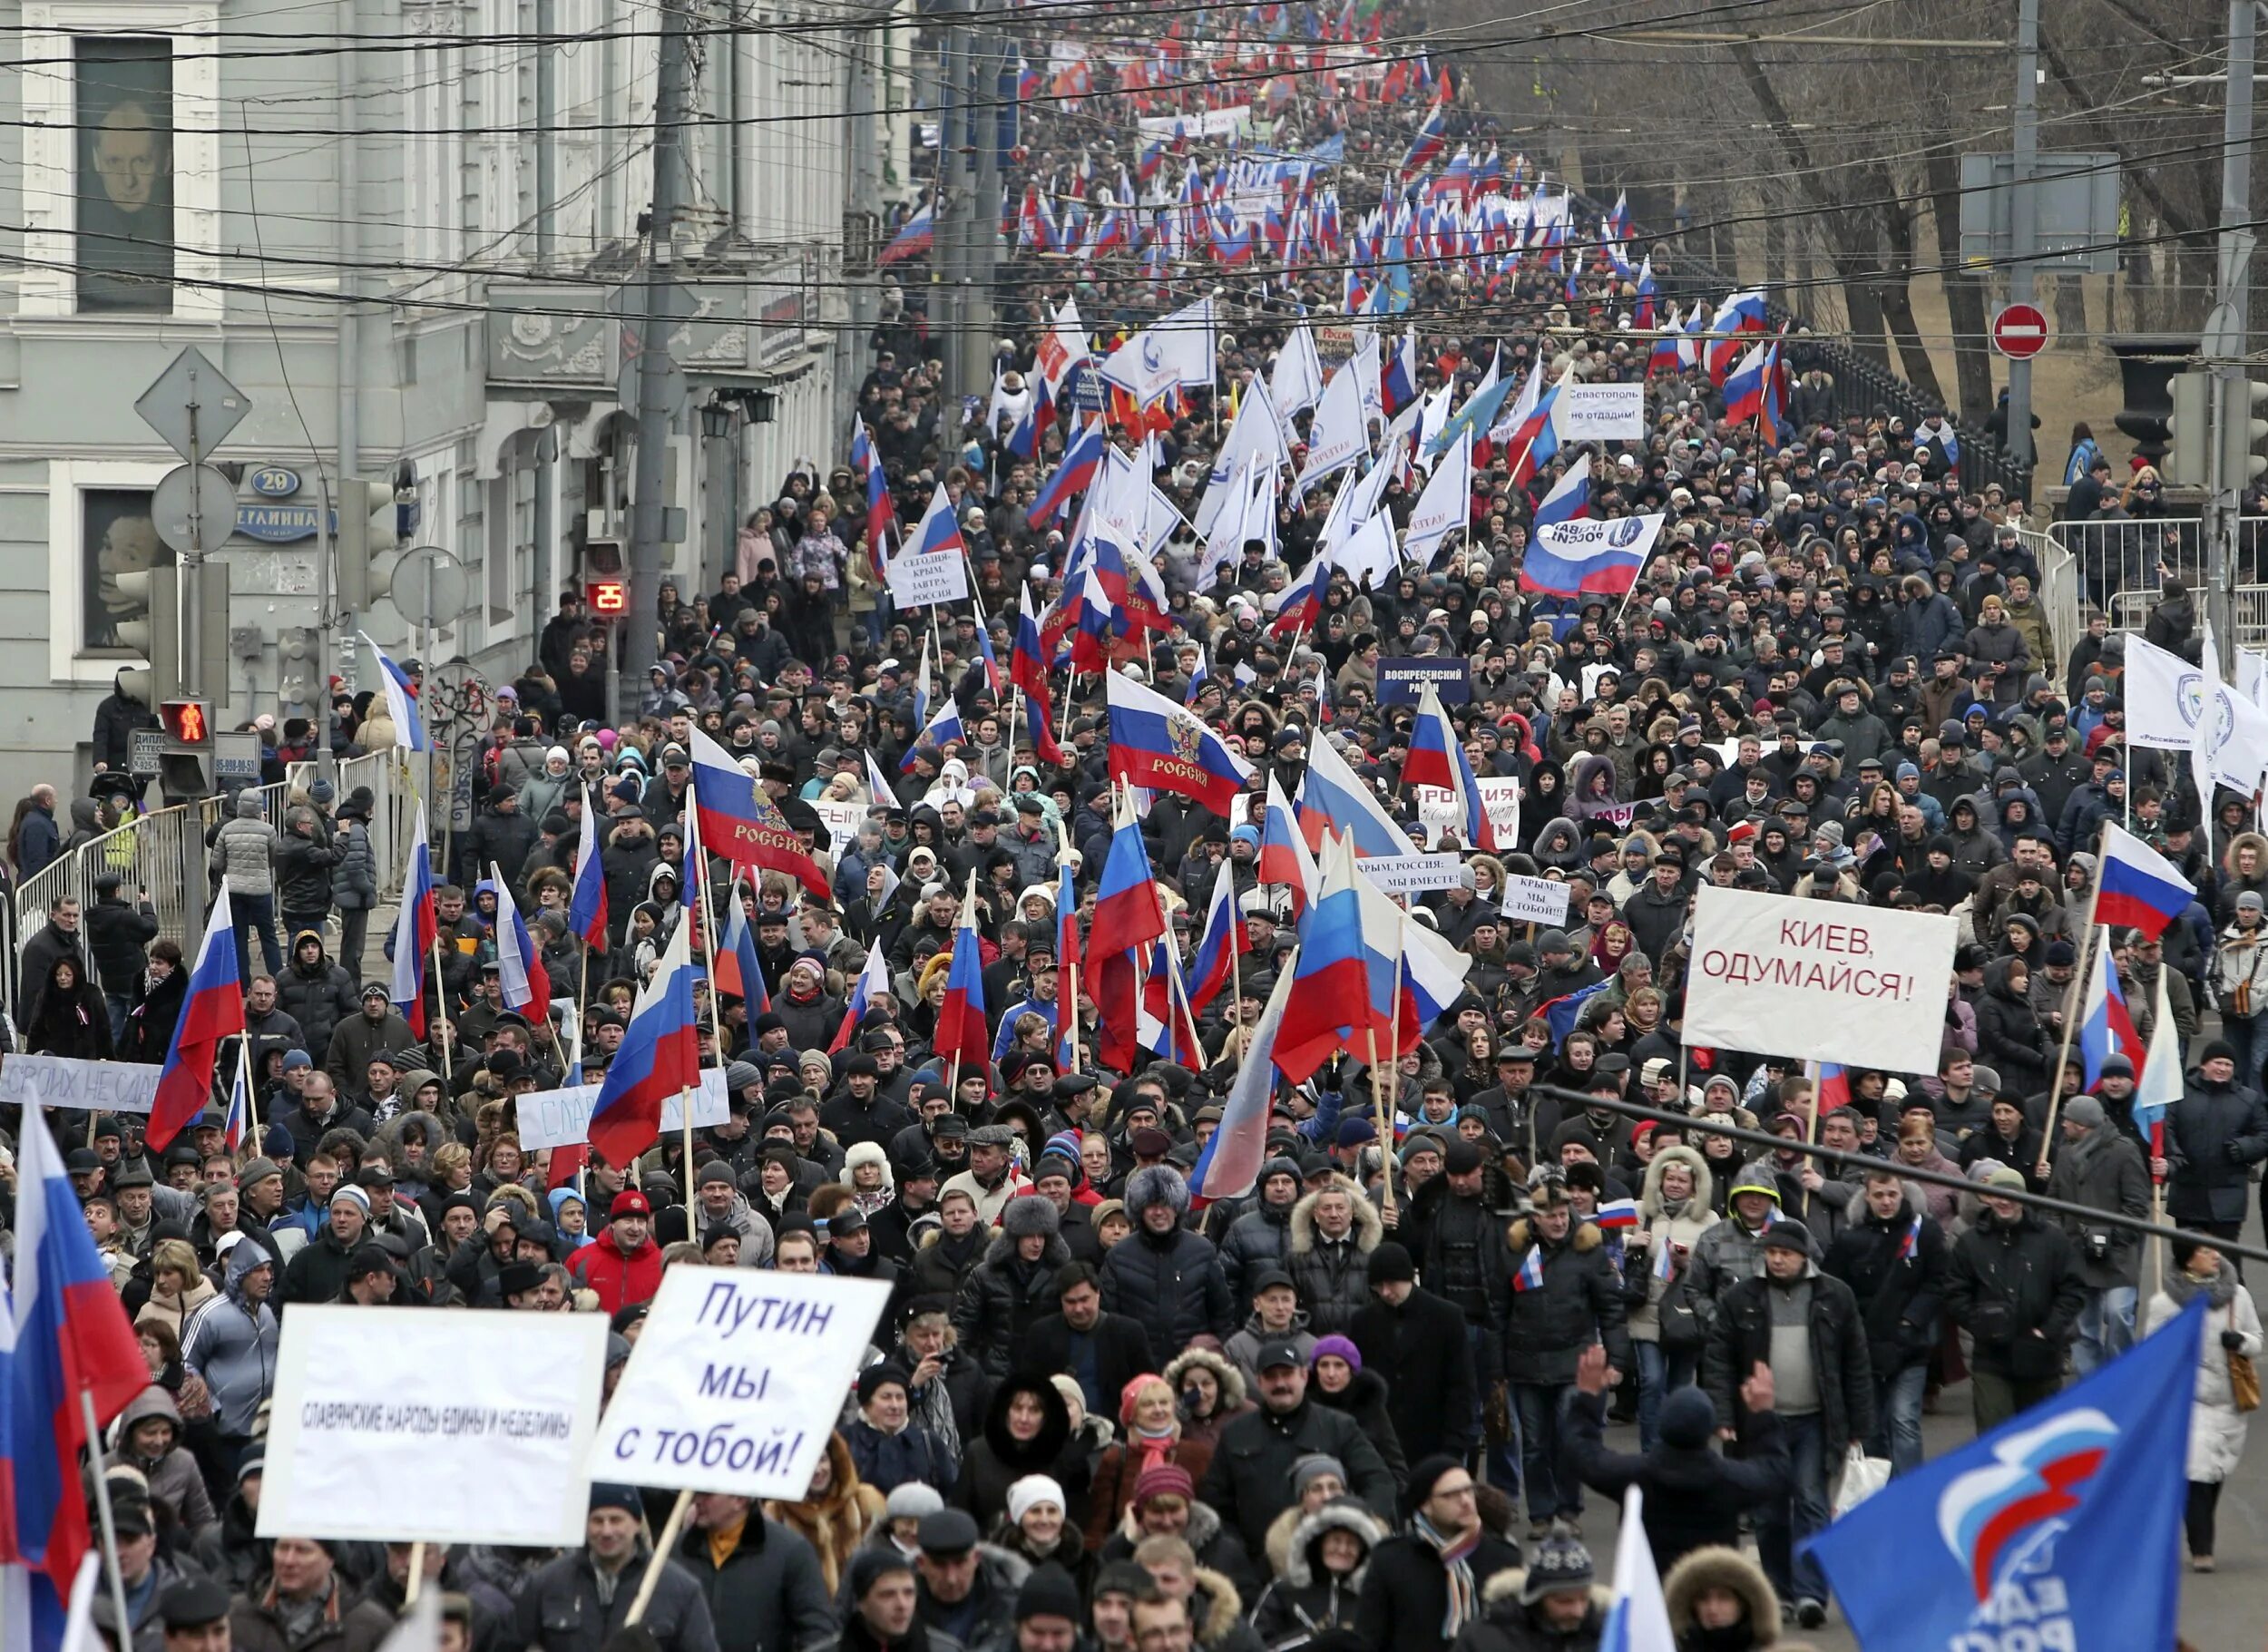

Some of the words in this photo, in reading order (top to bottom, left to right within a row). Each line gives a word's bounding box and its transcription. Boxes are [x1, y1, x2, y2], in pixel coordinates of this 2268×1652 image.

[1570, 390, 1638, 398] Севастополь
[1587, 411, 1635, 421] отдадим!
[262, 473, 288, 490] 29
[913, 589, 952, 602] РОССИЯ
[1385, 669, 1461, 680] ВОСКРЕСЕНСКИЙ
[1151, 758, 1207, 787] РОССИЯ
[734, 825, 807, 856] РОССИЯ
[1396, 860, 1444, 871] РОССИЯ:
[1387, 878, 1406, 887] МЫ
[1410, 875, 1459, 886] ВМЕСТЕ!
[1520, 878, 1558, 892] КРЫМ!
[1527, 893, 1546, 904] МЫ
[1506, 900, 1514, 909] С
[1517, 902, 1563, 917] ТОБОЙ!!!
[1780, 918, 1874, 959] КИЕВ,
[1703, 950, 1915, 1002] ОДУМАЙСЯ!
[696, 1282, 835, 1340] Путин
[386, 1405, 439, 1435] НАРОДЫ
[654, 1422, 805, 1476] тобой!
